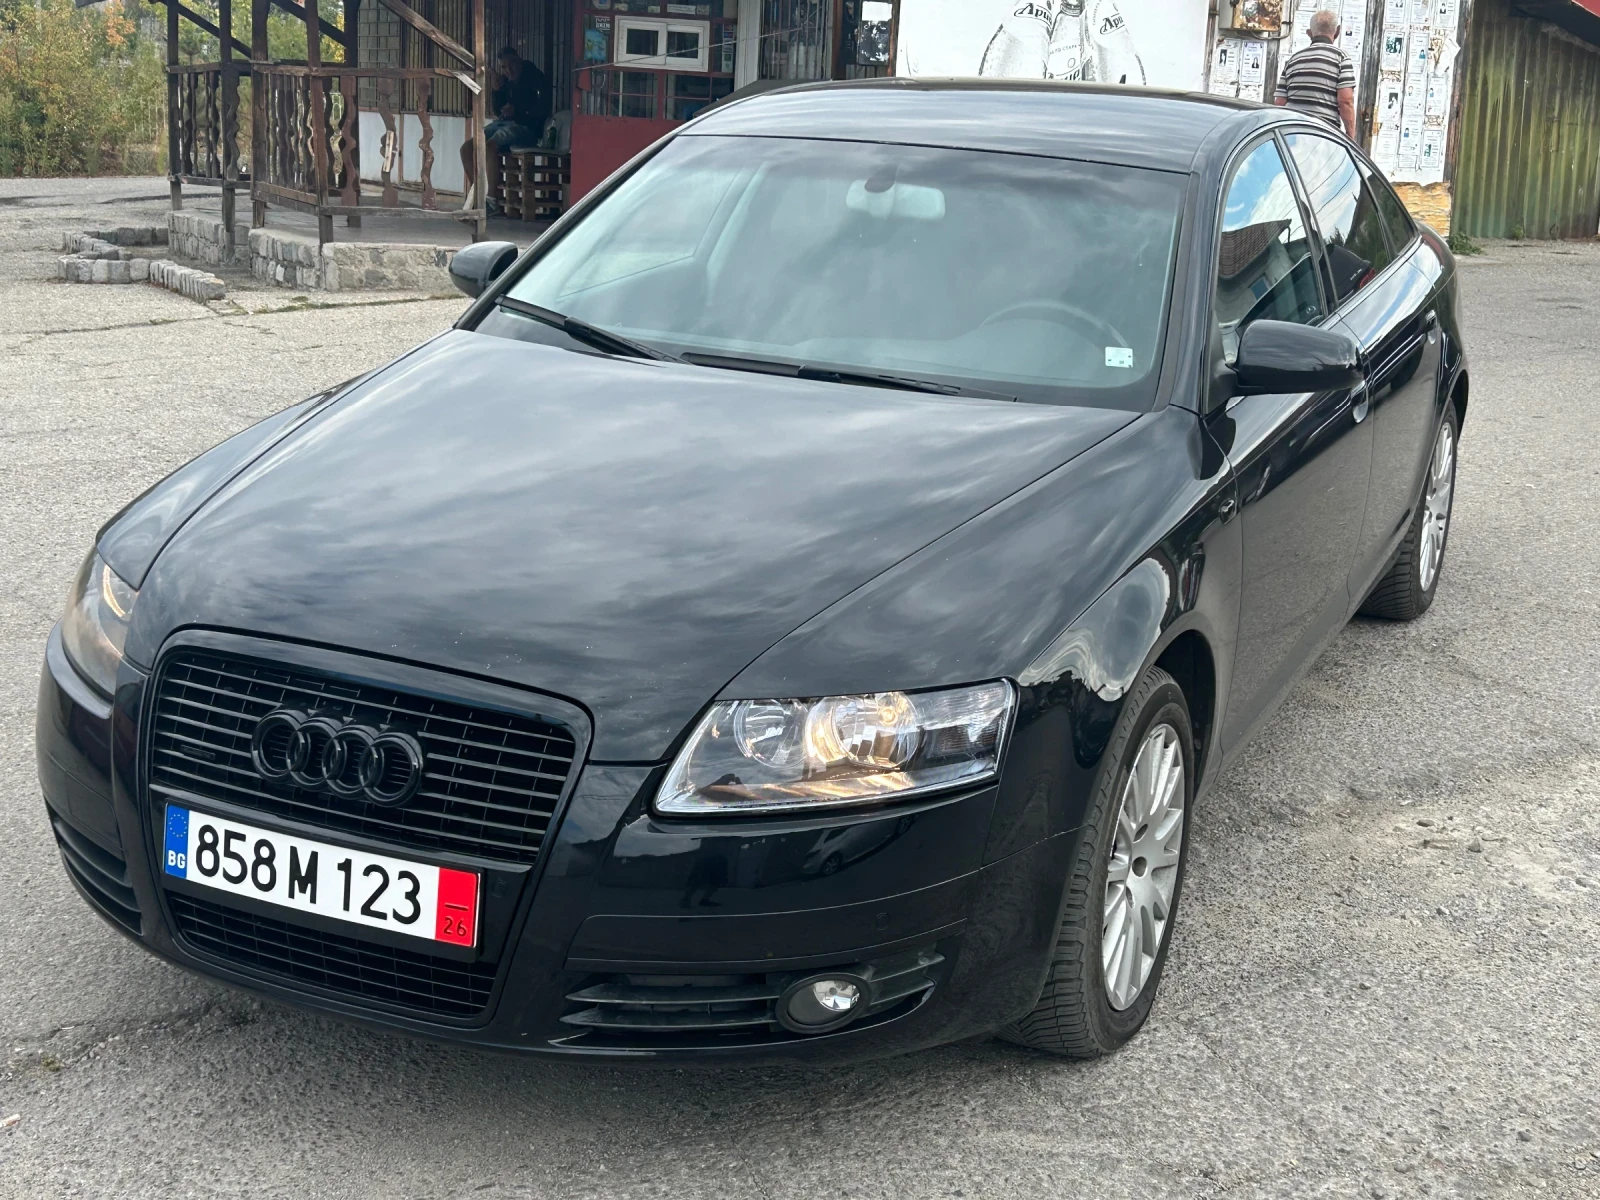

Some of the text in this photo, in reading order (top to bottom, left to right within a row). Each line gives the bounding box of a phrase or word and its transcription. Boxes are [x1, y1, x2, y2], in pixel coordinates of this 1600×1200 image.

[168, 849, 186, 869] BG
[195, 824, 421, 925] 858 M 123
[443, 916, 467, 937] 26
